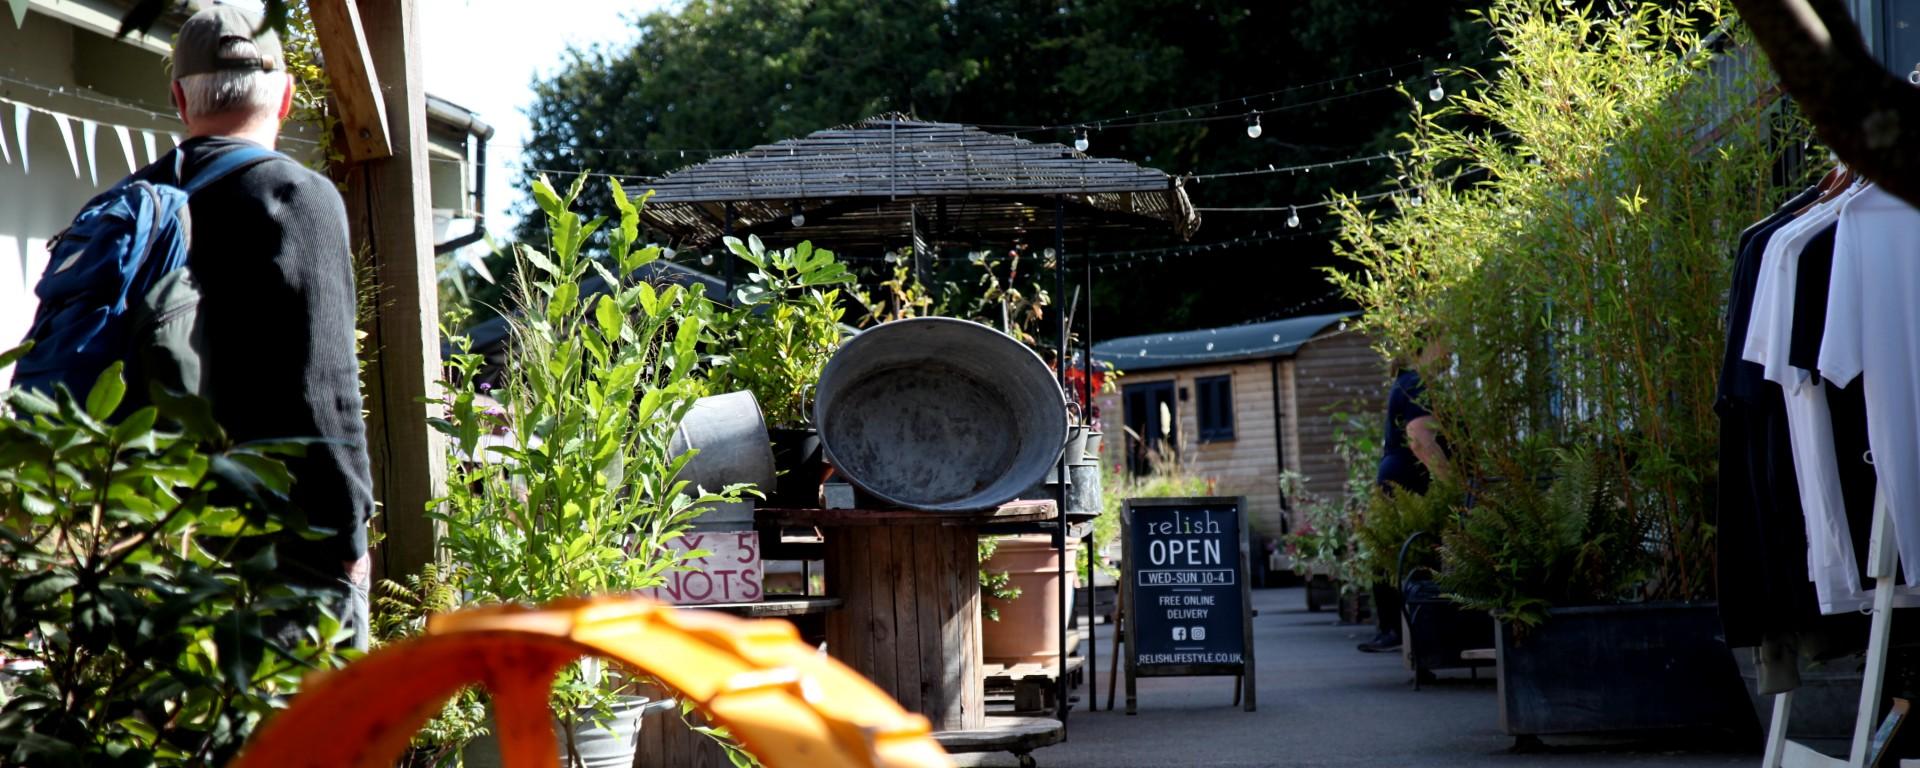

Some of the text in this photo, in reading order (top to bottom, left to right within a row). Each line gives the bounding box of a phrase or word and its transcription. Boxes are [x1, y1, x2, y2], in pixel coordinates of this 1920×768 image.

[1148, 511, 1221, 535] relish
[737, 534, 755, 564] 5
[1149, 539, 1221, 565] OPEN
[633, 570, 760, 601] NOTS
[1148, 572, 1225, 584] WED-SUN 10-4
[1159, 596, 1215, 606] FREE ONLINE
[1167, 609, 1208, 619] DELIVERY
[1140, 653, 1241, 664] RELISHLIFESTYLE.CO.UK
